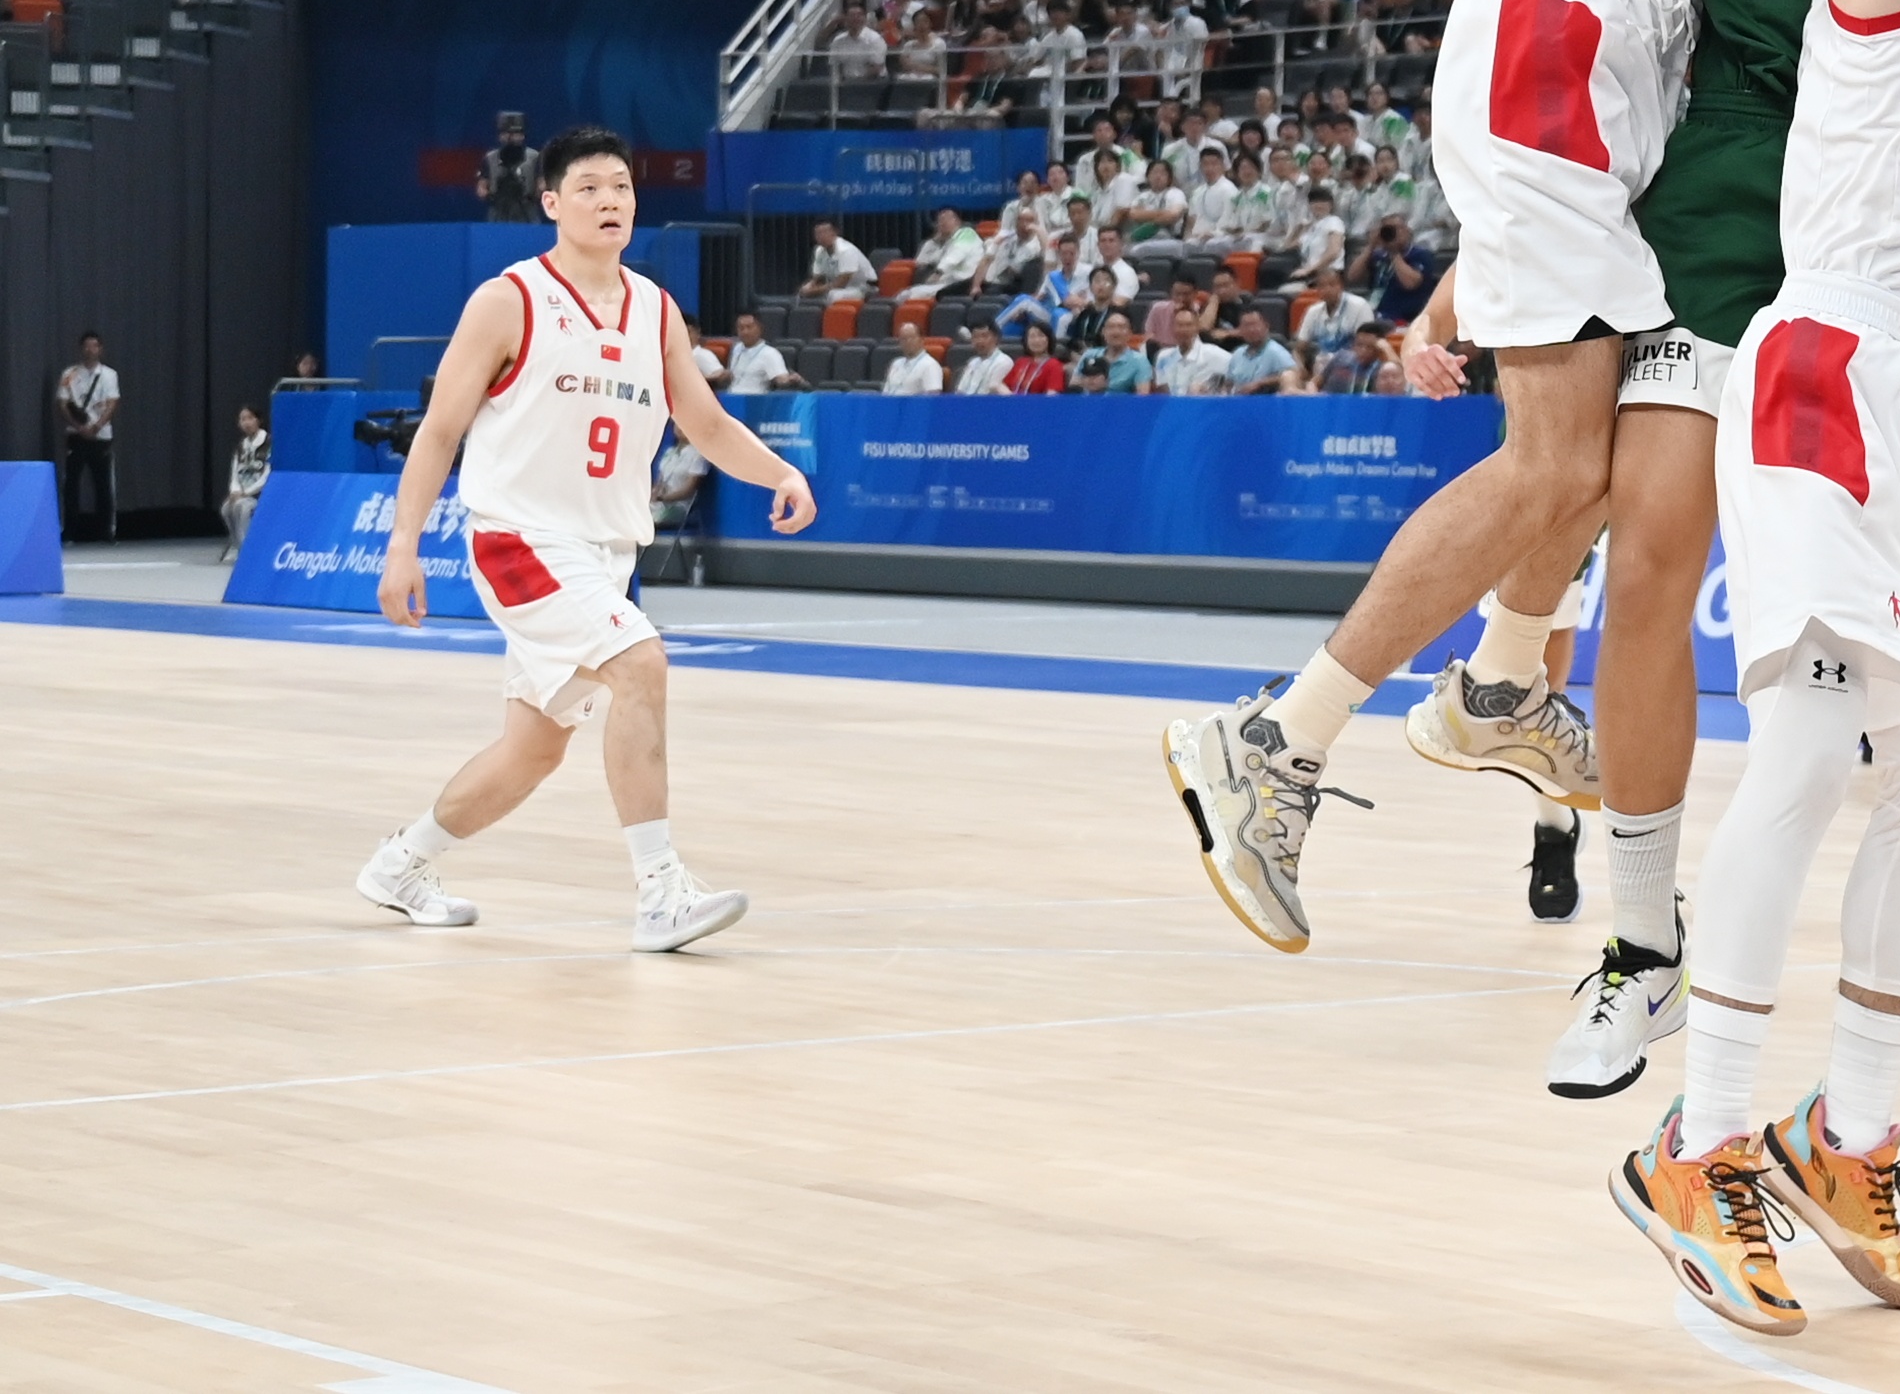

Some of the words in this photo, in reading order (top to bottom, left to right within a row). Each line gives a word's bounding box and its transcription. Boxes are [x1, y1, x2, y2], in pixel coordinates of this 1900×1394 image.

[555, 374, 652, 407] CHINA
[587, 416, 620, 479] 9
[863, 441, 886, 457] FISU
[887, 442, 926, 458] WORLD
[927, 442, 990, 459] UNIVERSITY
[991, 443, 1030, 461] GAMES
[273, 541, 344, 580] Chengdu
